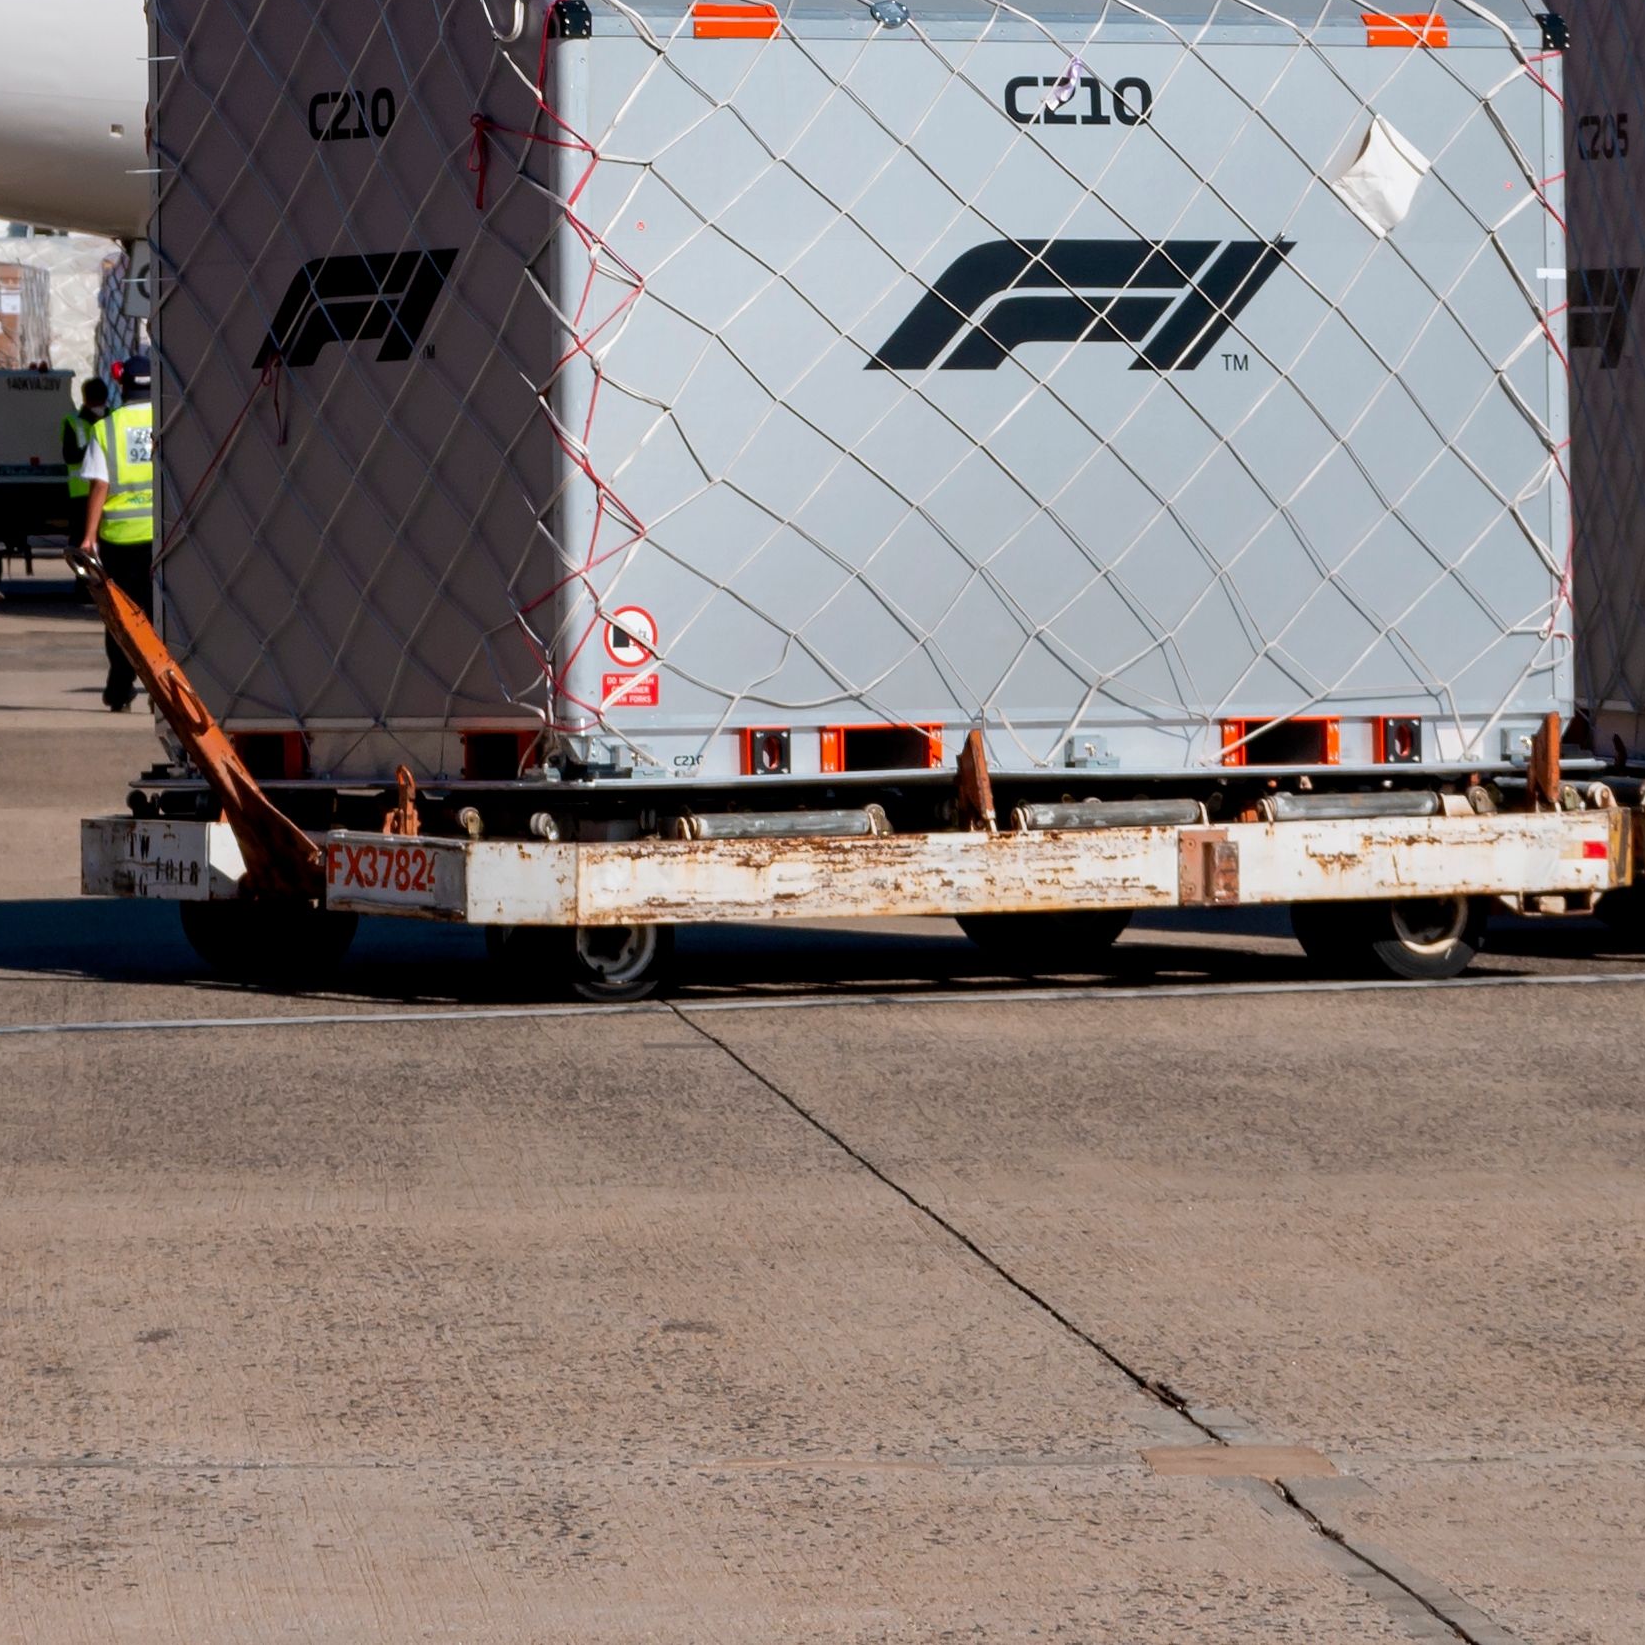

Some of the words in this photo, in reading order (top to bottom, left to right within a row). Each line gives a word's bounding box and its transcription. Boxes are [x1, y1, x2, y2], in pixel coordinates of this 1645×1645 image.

[308, 87, 396, 142] C210
[1004, 76, 1153, 125] C210
[1221, 354, 1249, 372] TM
